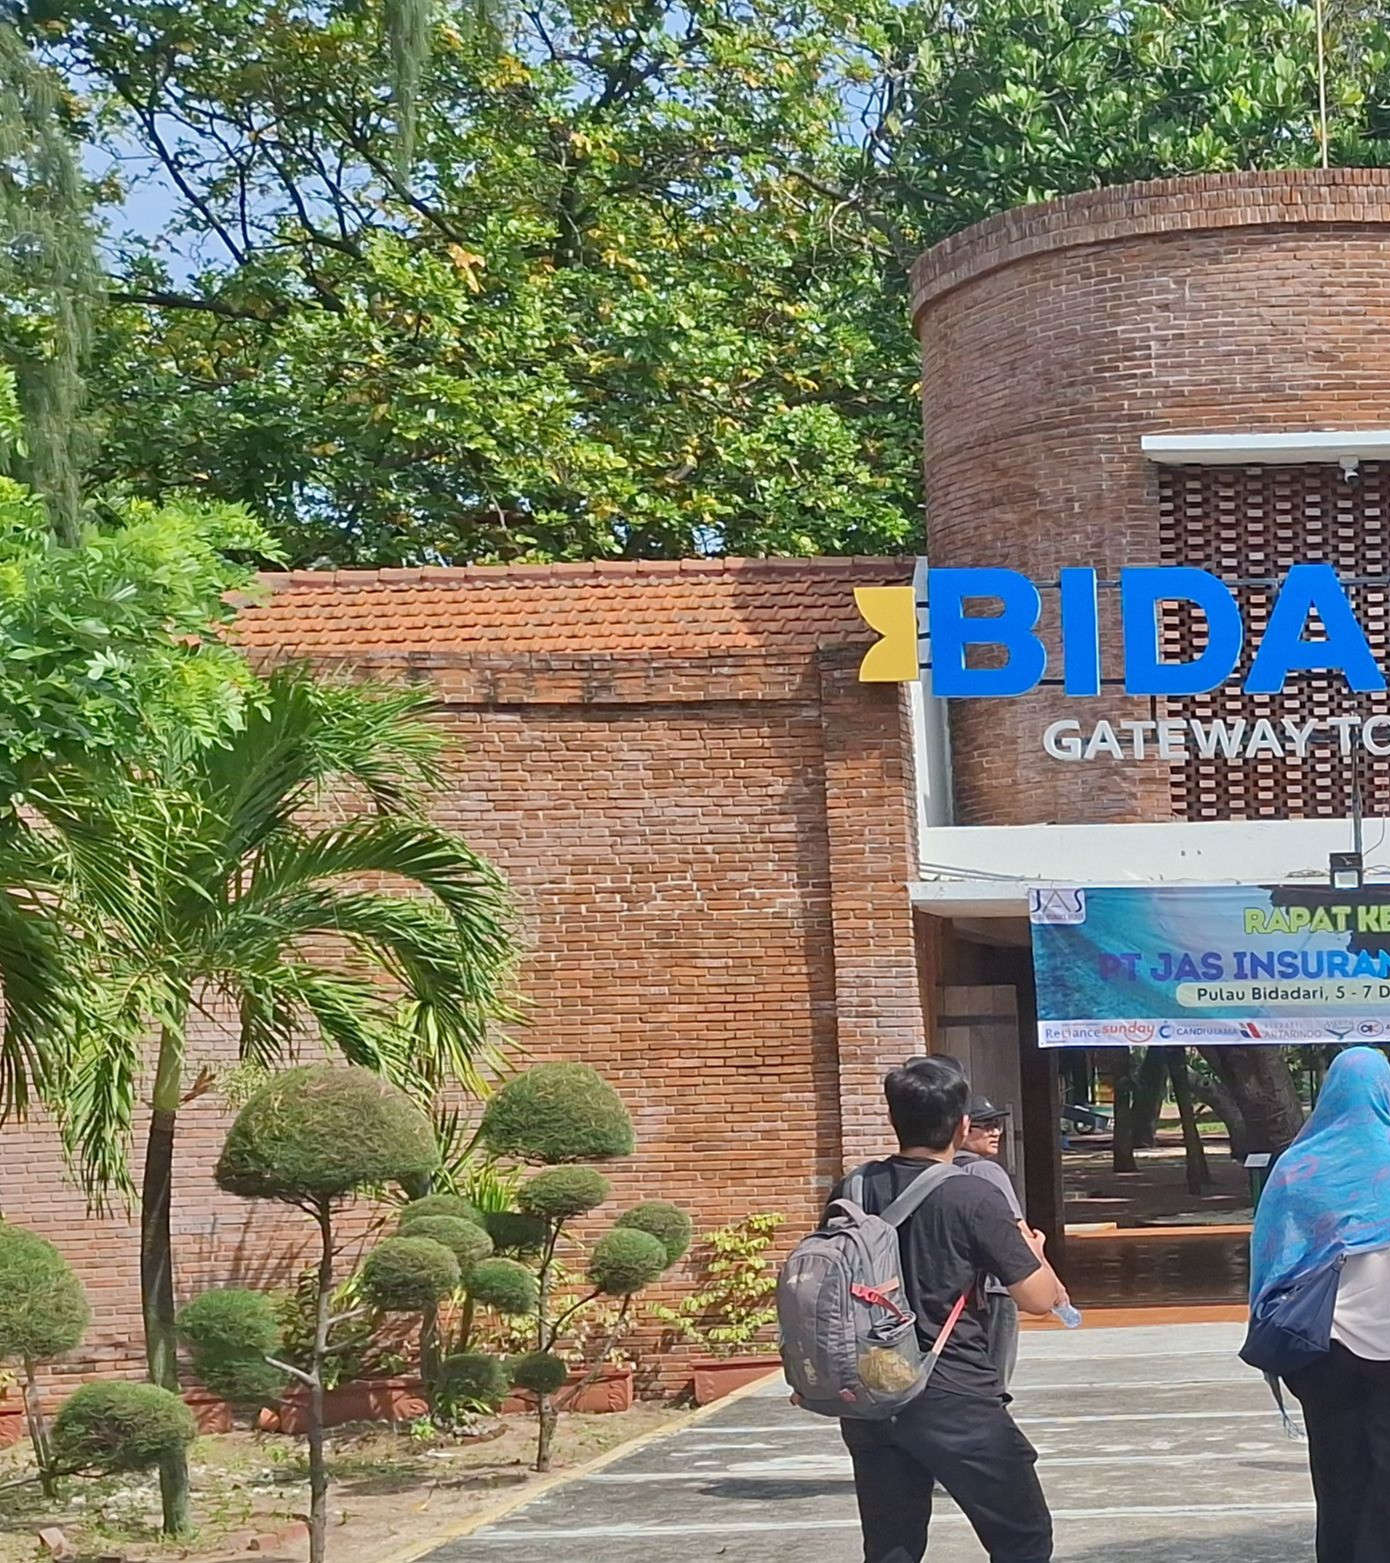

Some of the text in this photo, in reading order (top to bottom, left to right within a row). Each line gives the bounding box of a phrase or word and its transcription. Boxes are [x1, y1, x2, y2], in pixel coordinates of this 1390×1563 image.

[1043, 718, 1319, 761] GATEWAY
[1030, 889, 1083, 912] JAS
[1243, 905, 1351, 934] RAPAT
[1098, 953, 1141, 981] PT
[1150, 951, 1224, 981] JAS
[1197, 987, 1245, 1001] Pulau
[1251, 985, 1329, 1002] Bidadari,
[1336, 986, 1345, 999] 5
[1363, 985, 1372, 999] 7
[1102, 1021, 1155, 1041] sunday
